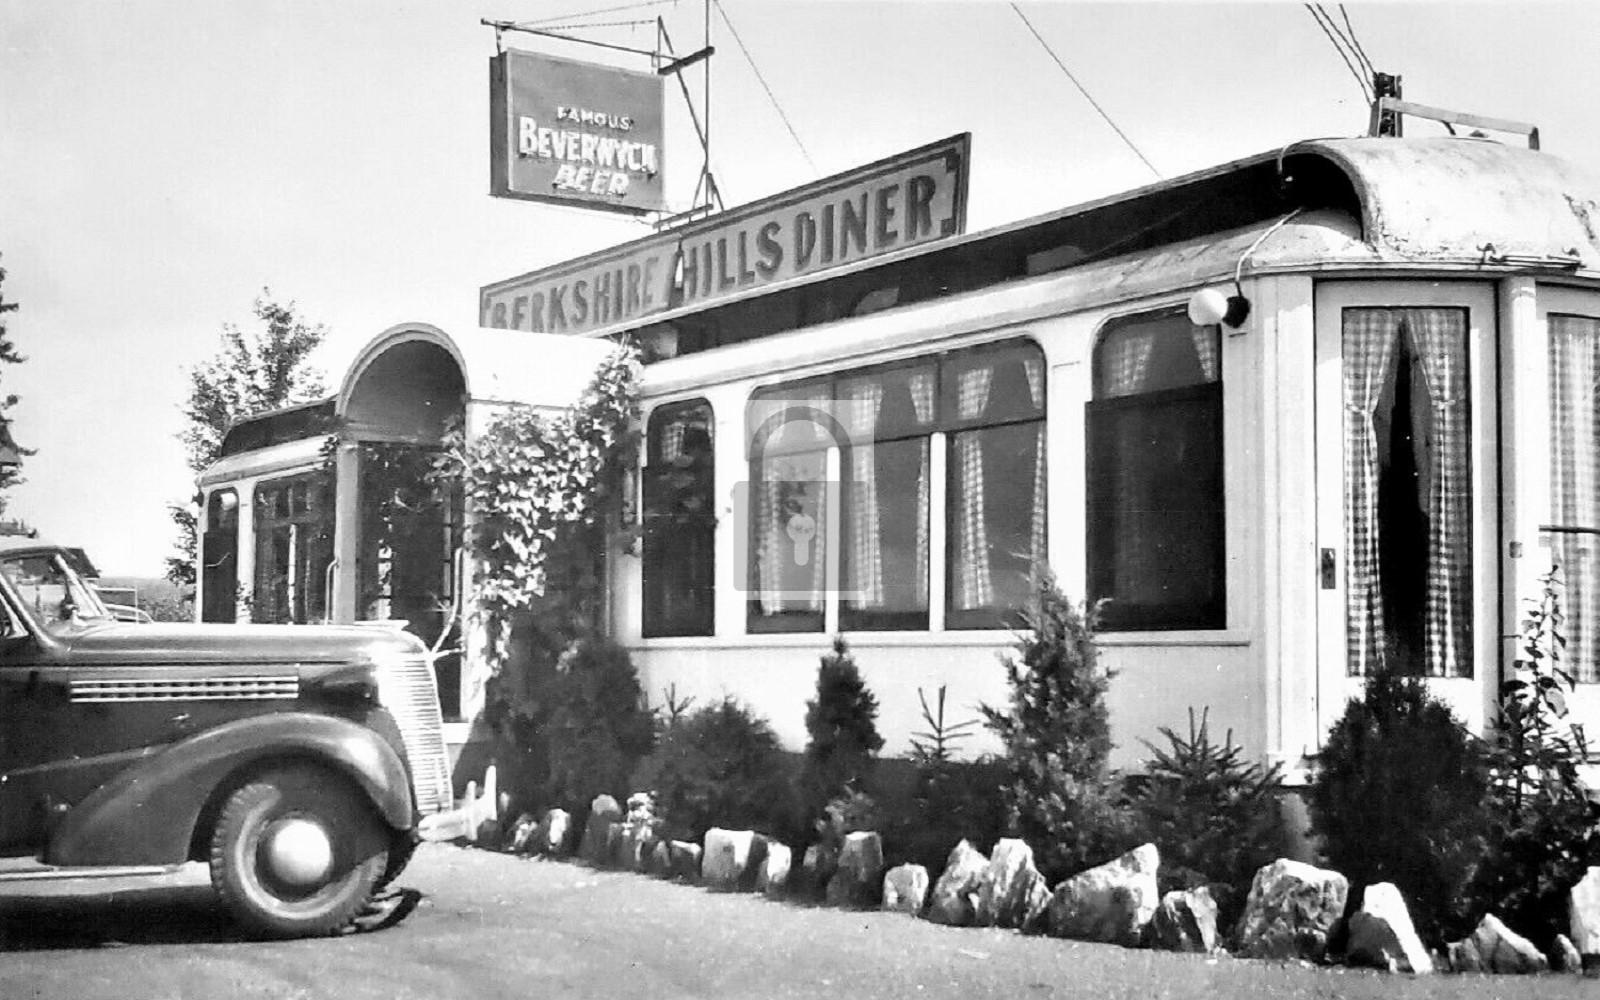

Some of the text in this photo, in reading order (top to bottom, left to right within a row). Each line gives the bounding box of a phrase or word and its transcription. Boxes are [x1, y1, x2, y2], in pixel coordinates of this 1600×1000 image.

[557, 106, 632, 131] FAMOUS
[519, 116, 657, 174] BEVERWYCK
[554, 164, 630, 196] BEER
[491, 174, 936, 333] BERKSHIRE HILLS DINER
